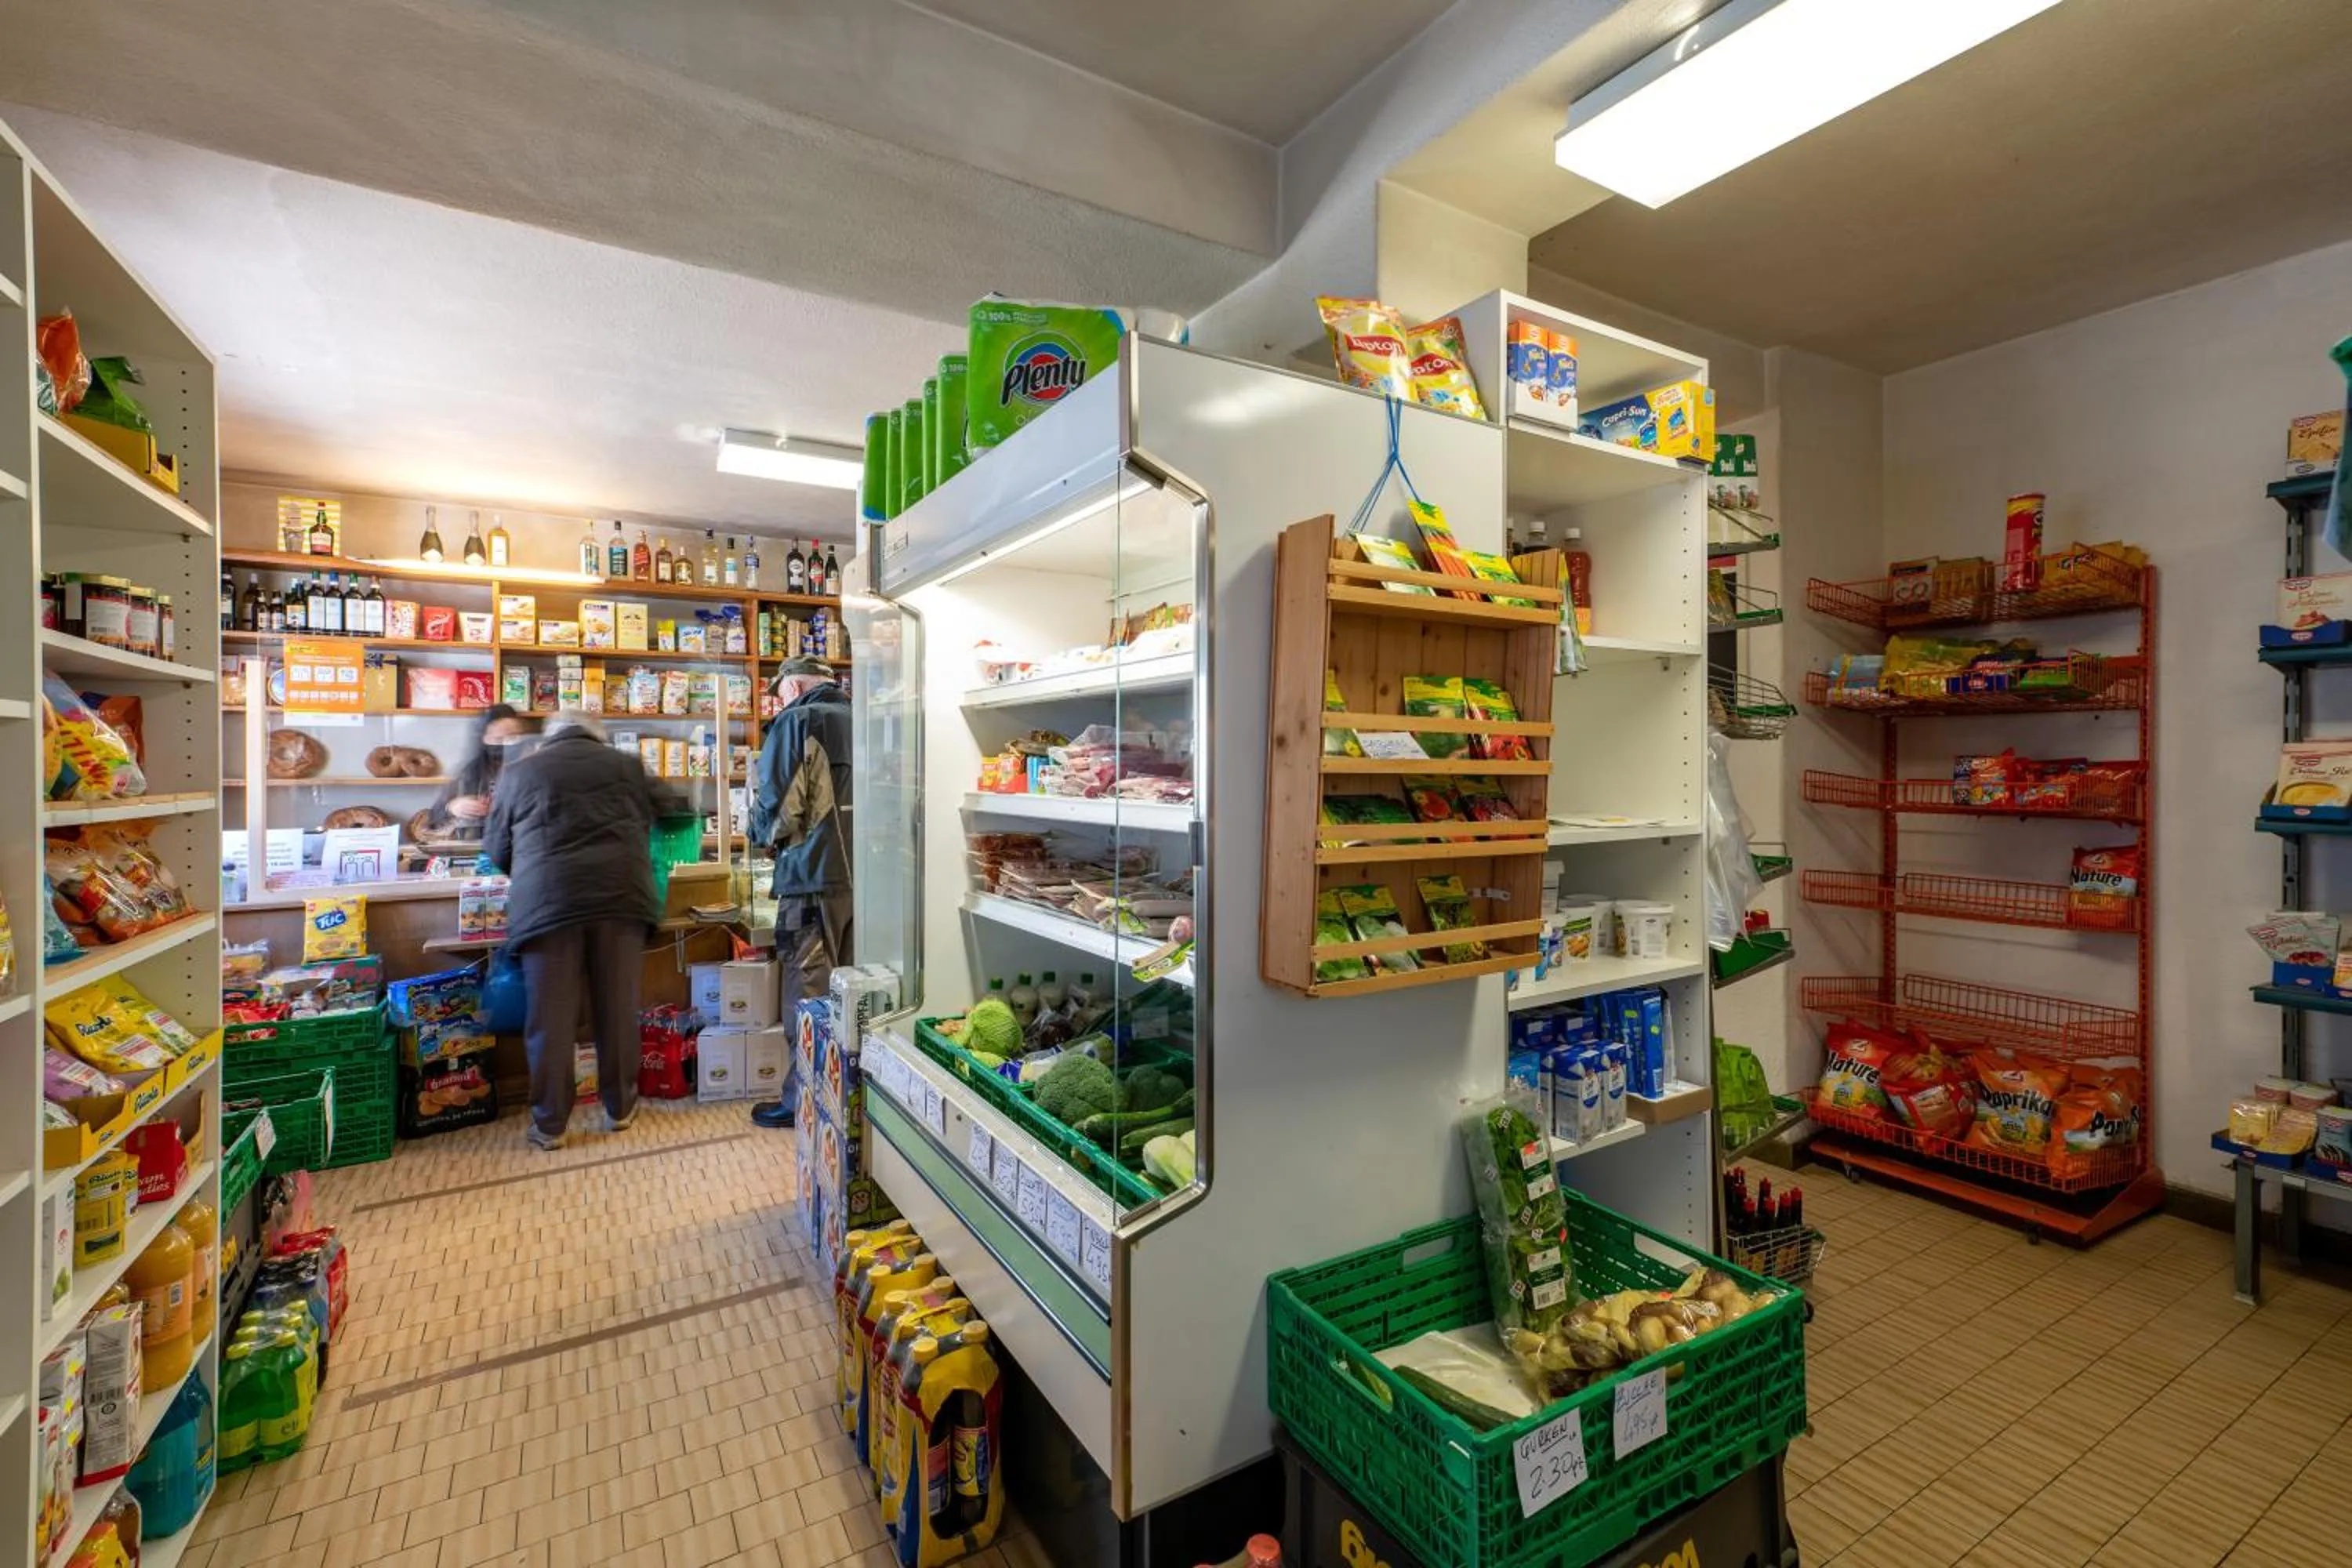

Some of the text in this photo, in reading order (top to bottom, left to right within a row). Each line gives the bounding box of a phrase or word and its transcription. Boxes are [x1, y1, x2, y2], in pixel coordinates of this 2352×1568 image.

[1000, 355, 1086, 406] Plenty
[2071, 867, 2122, 887] Nature
[1980, 1083, 2053, 1117] Paprika
